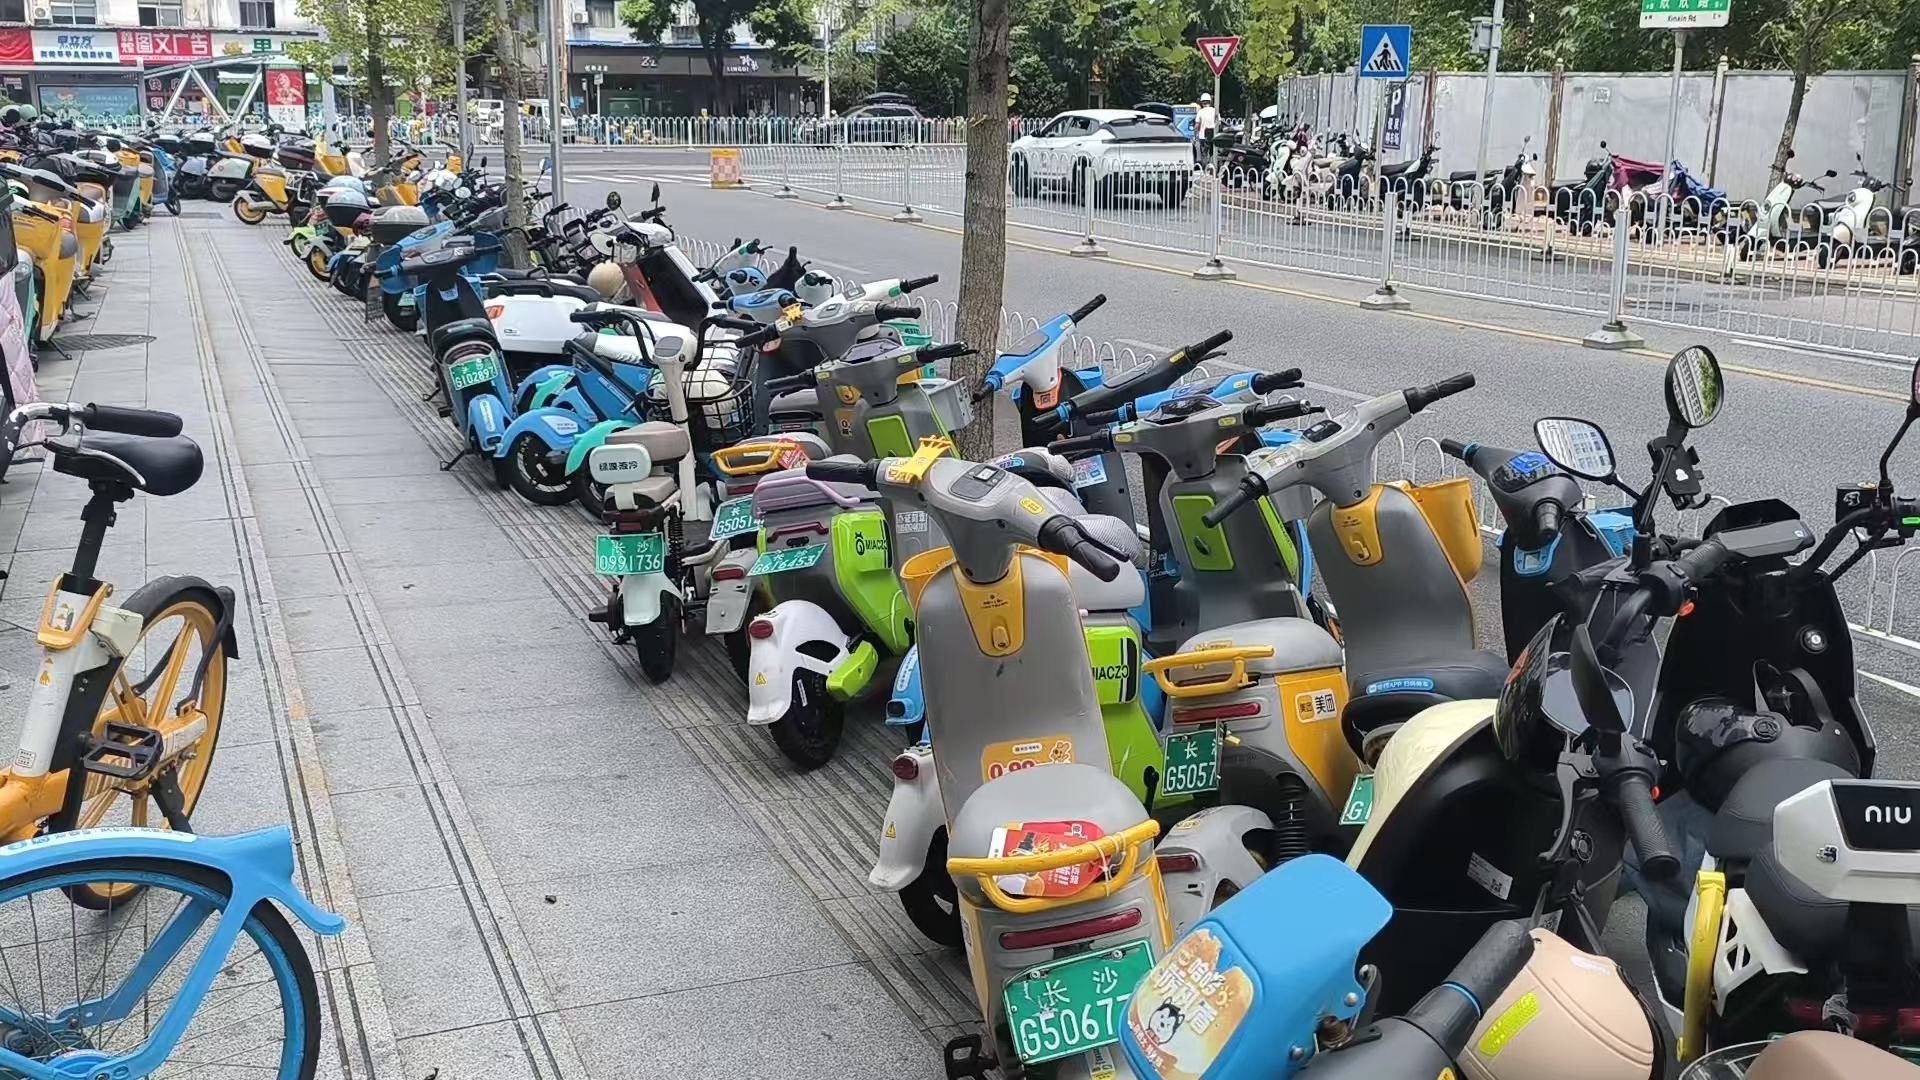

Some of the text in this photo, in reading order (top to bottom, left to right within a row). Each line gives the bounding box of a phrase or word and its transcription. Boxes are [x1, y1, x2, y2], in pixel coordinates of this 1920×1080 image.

[136, 32, 209, 55] 图文广告
[1211, 44, 1224, 57] 让
[1390, 88, 1402, 116] P
[612, 540, 651, 554] 长沙
[772, 549, 809, 562] 长沙
[599, 553, 661, 571] 0991736
[1314, 694, 1336, 714] 美团
[1042, 966, 1119, 1005] 长沙
